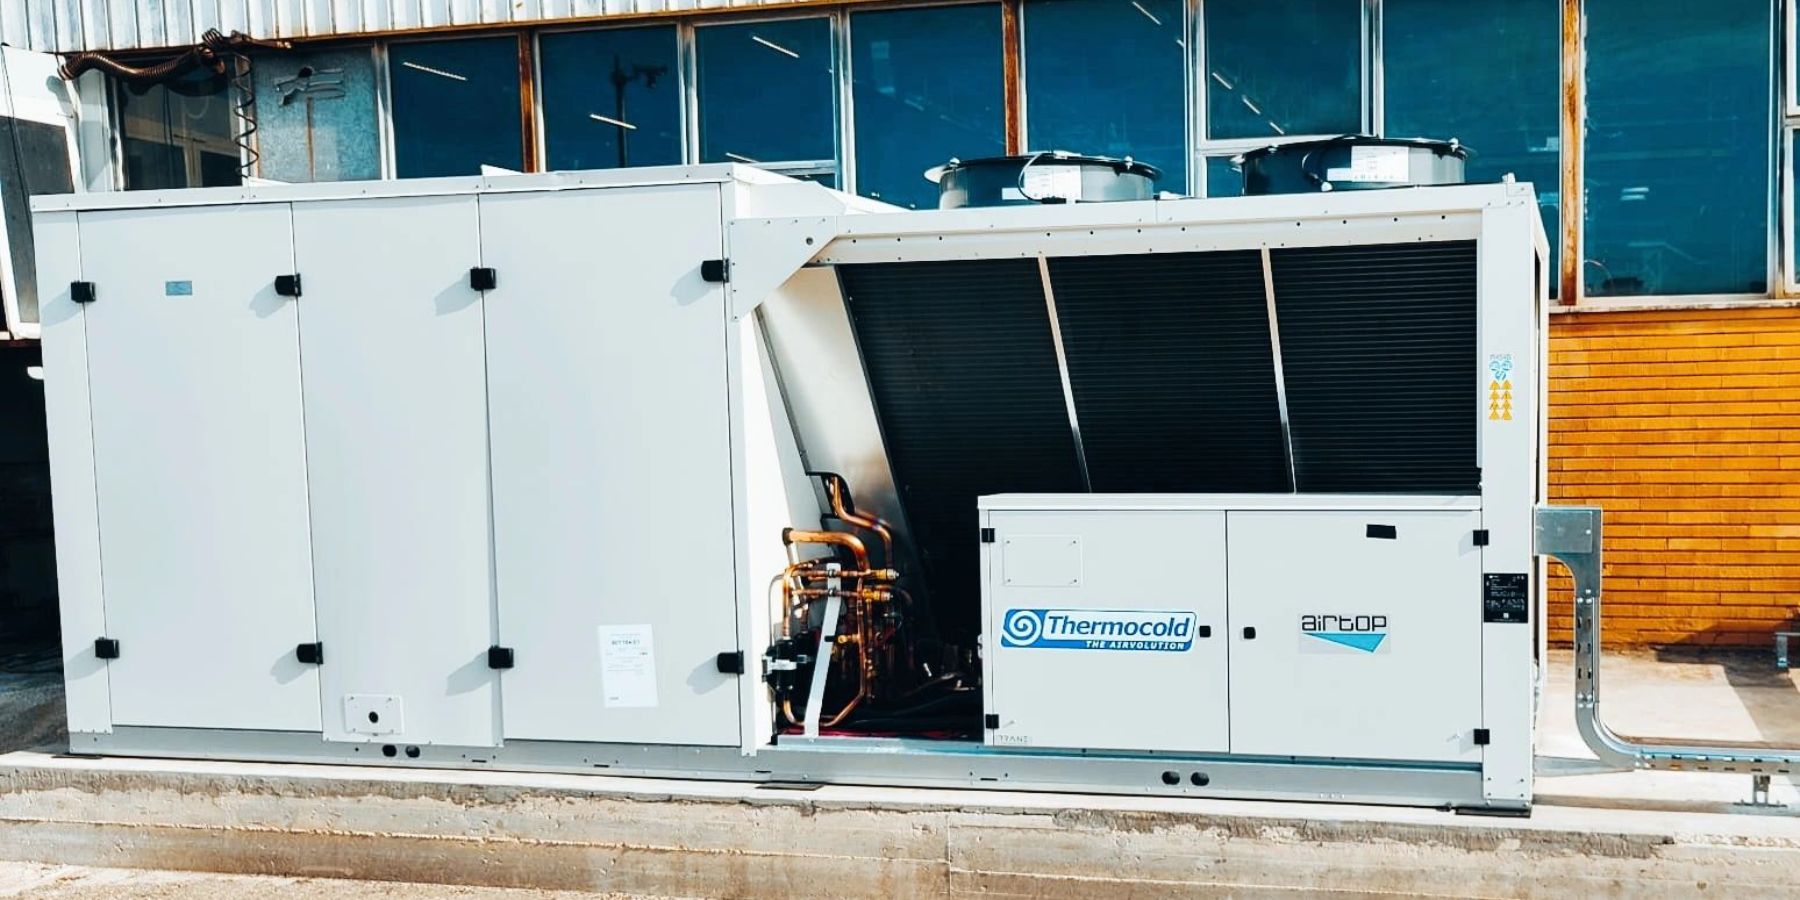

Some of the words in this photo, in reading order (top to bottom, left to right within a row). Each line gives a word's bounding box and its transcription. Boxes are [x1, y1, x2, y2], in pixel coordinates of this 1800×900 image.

[1048, 616, 1190, 637] Thermocold
[1086, 640, 1105, 649] THE
[1109, 641, 1184, 650] AIRVOLUTION
